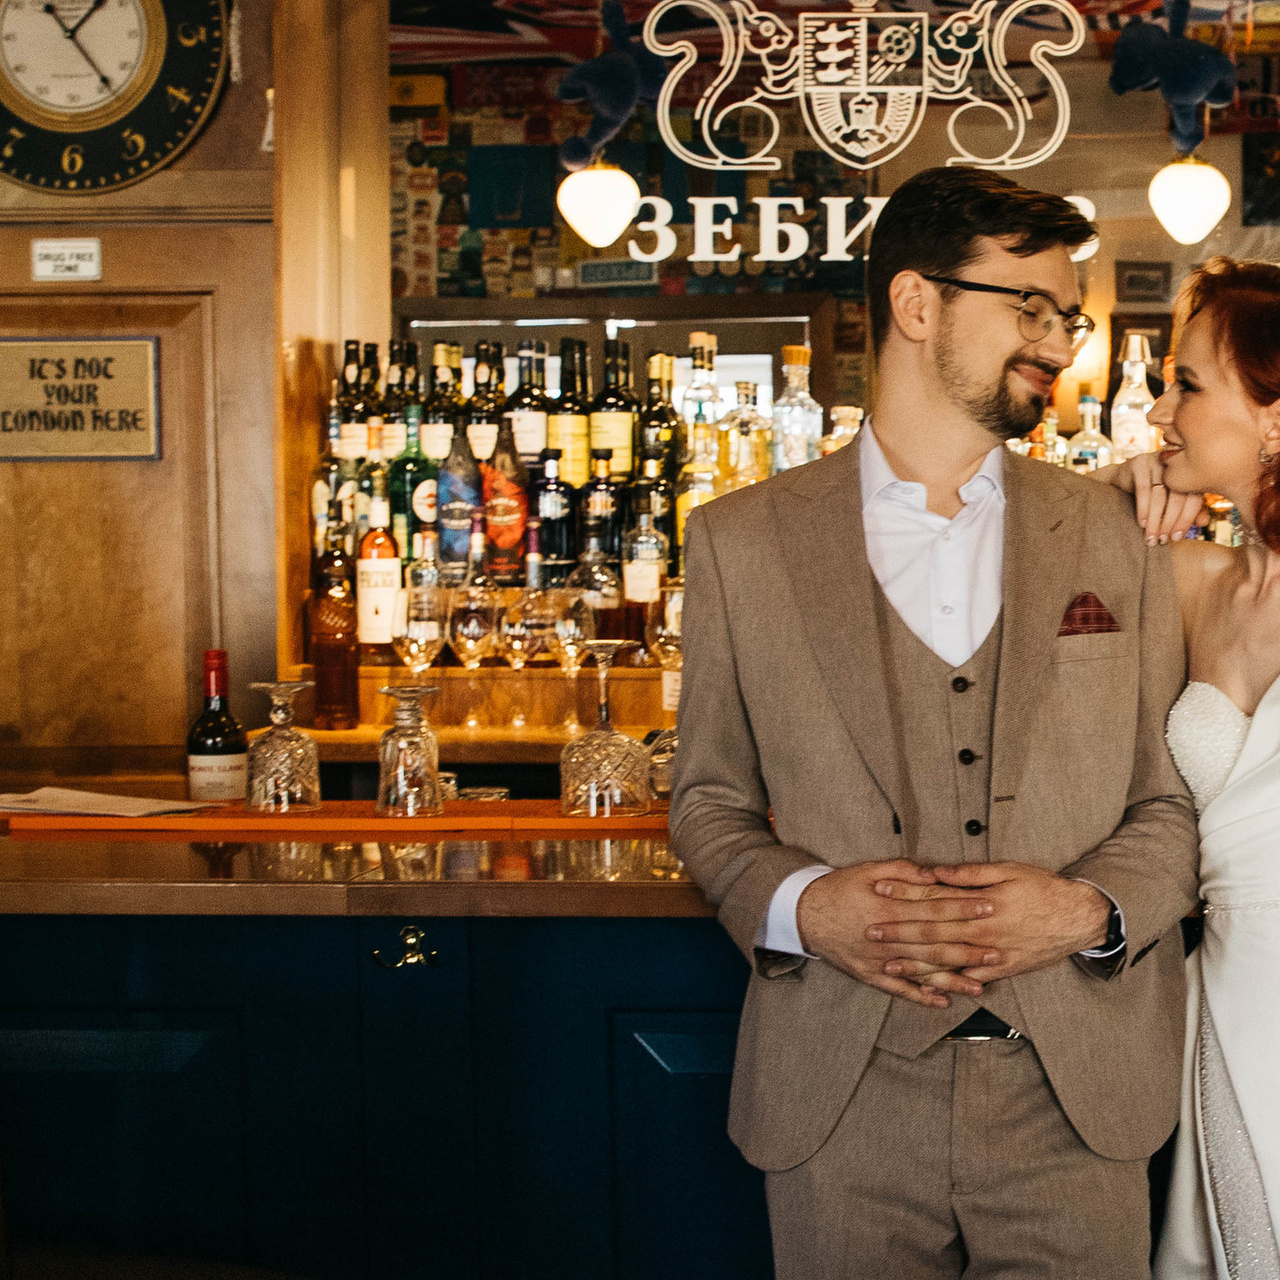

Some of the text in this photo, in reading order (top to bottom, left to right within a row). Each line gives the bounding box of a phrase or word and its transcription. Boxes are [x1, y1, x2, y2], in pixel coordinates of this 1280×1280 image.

[178, 21, 207, 48] 3
[120, 127, 147, 161] 5
[61, 143, 84, 175] 6
[73, 356, 115, 380] NOT
[43, 383, 99, 406] YOUR
[90, 407, 146, 432] HERE
